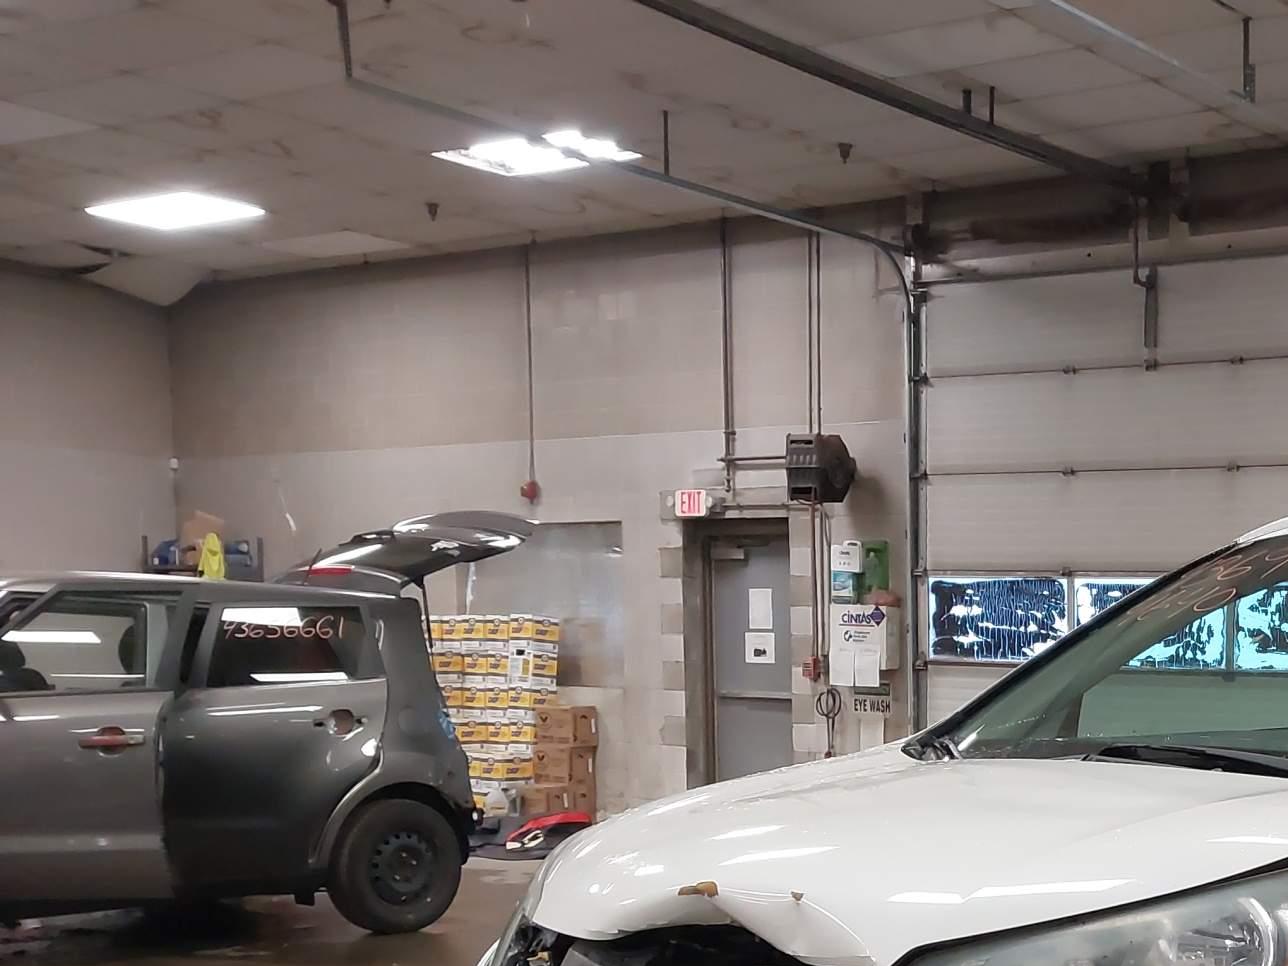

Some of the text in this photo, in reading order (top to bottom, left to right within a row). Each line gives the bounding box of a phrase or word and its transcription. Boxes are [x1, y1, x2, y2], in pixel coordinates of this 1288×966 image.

[680, 491, 702, 514] EXIT
[841, 610, 872, 625] CINTAS
[854, 698, 891, 713] EYE WASH
